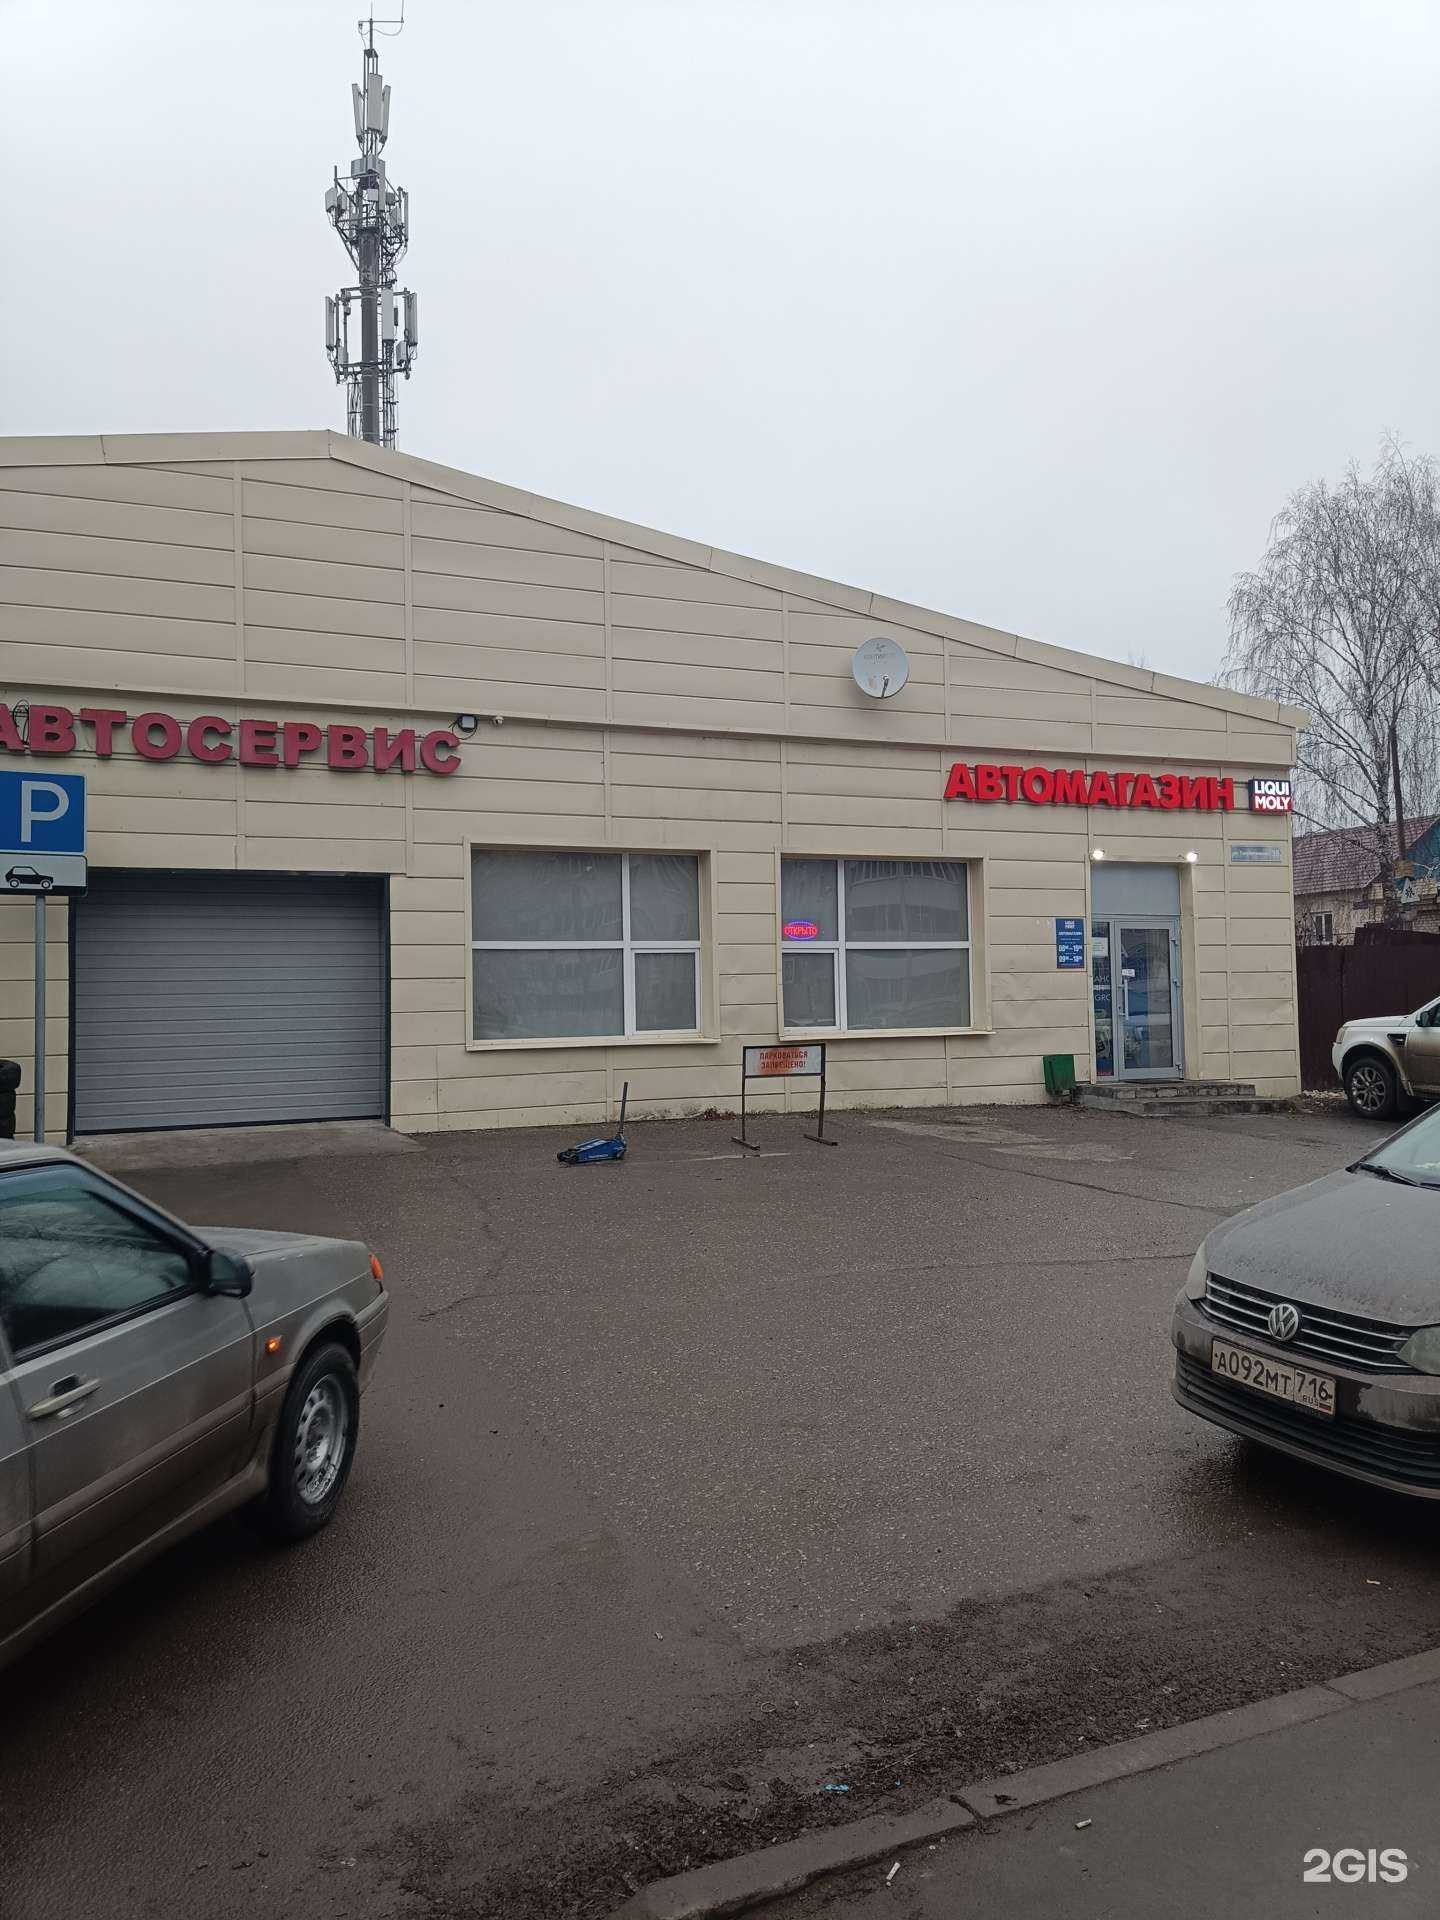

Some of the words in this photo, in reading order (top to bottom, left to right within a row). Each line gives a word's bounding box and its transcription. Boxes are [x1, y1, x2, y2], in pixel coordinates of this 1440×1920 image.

[944, 763, 1235, 811] АВТОМАГАЗИН
[1254, 780, 1290, 796] LIQUI
[20, 780, 69, 842] P
[1254, 795, 1291, 811] MOLY
[784, 926, 817, 935] ОТКРЫТО
